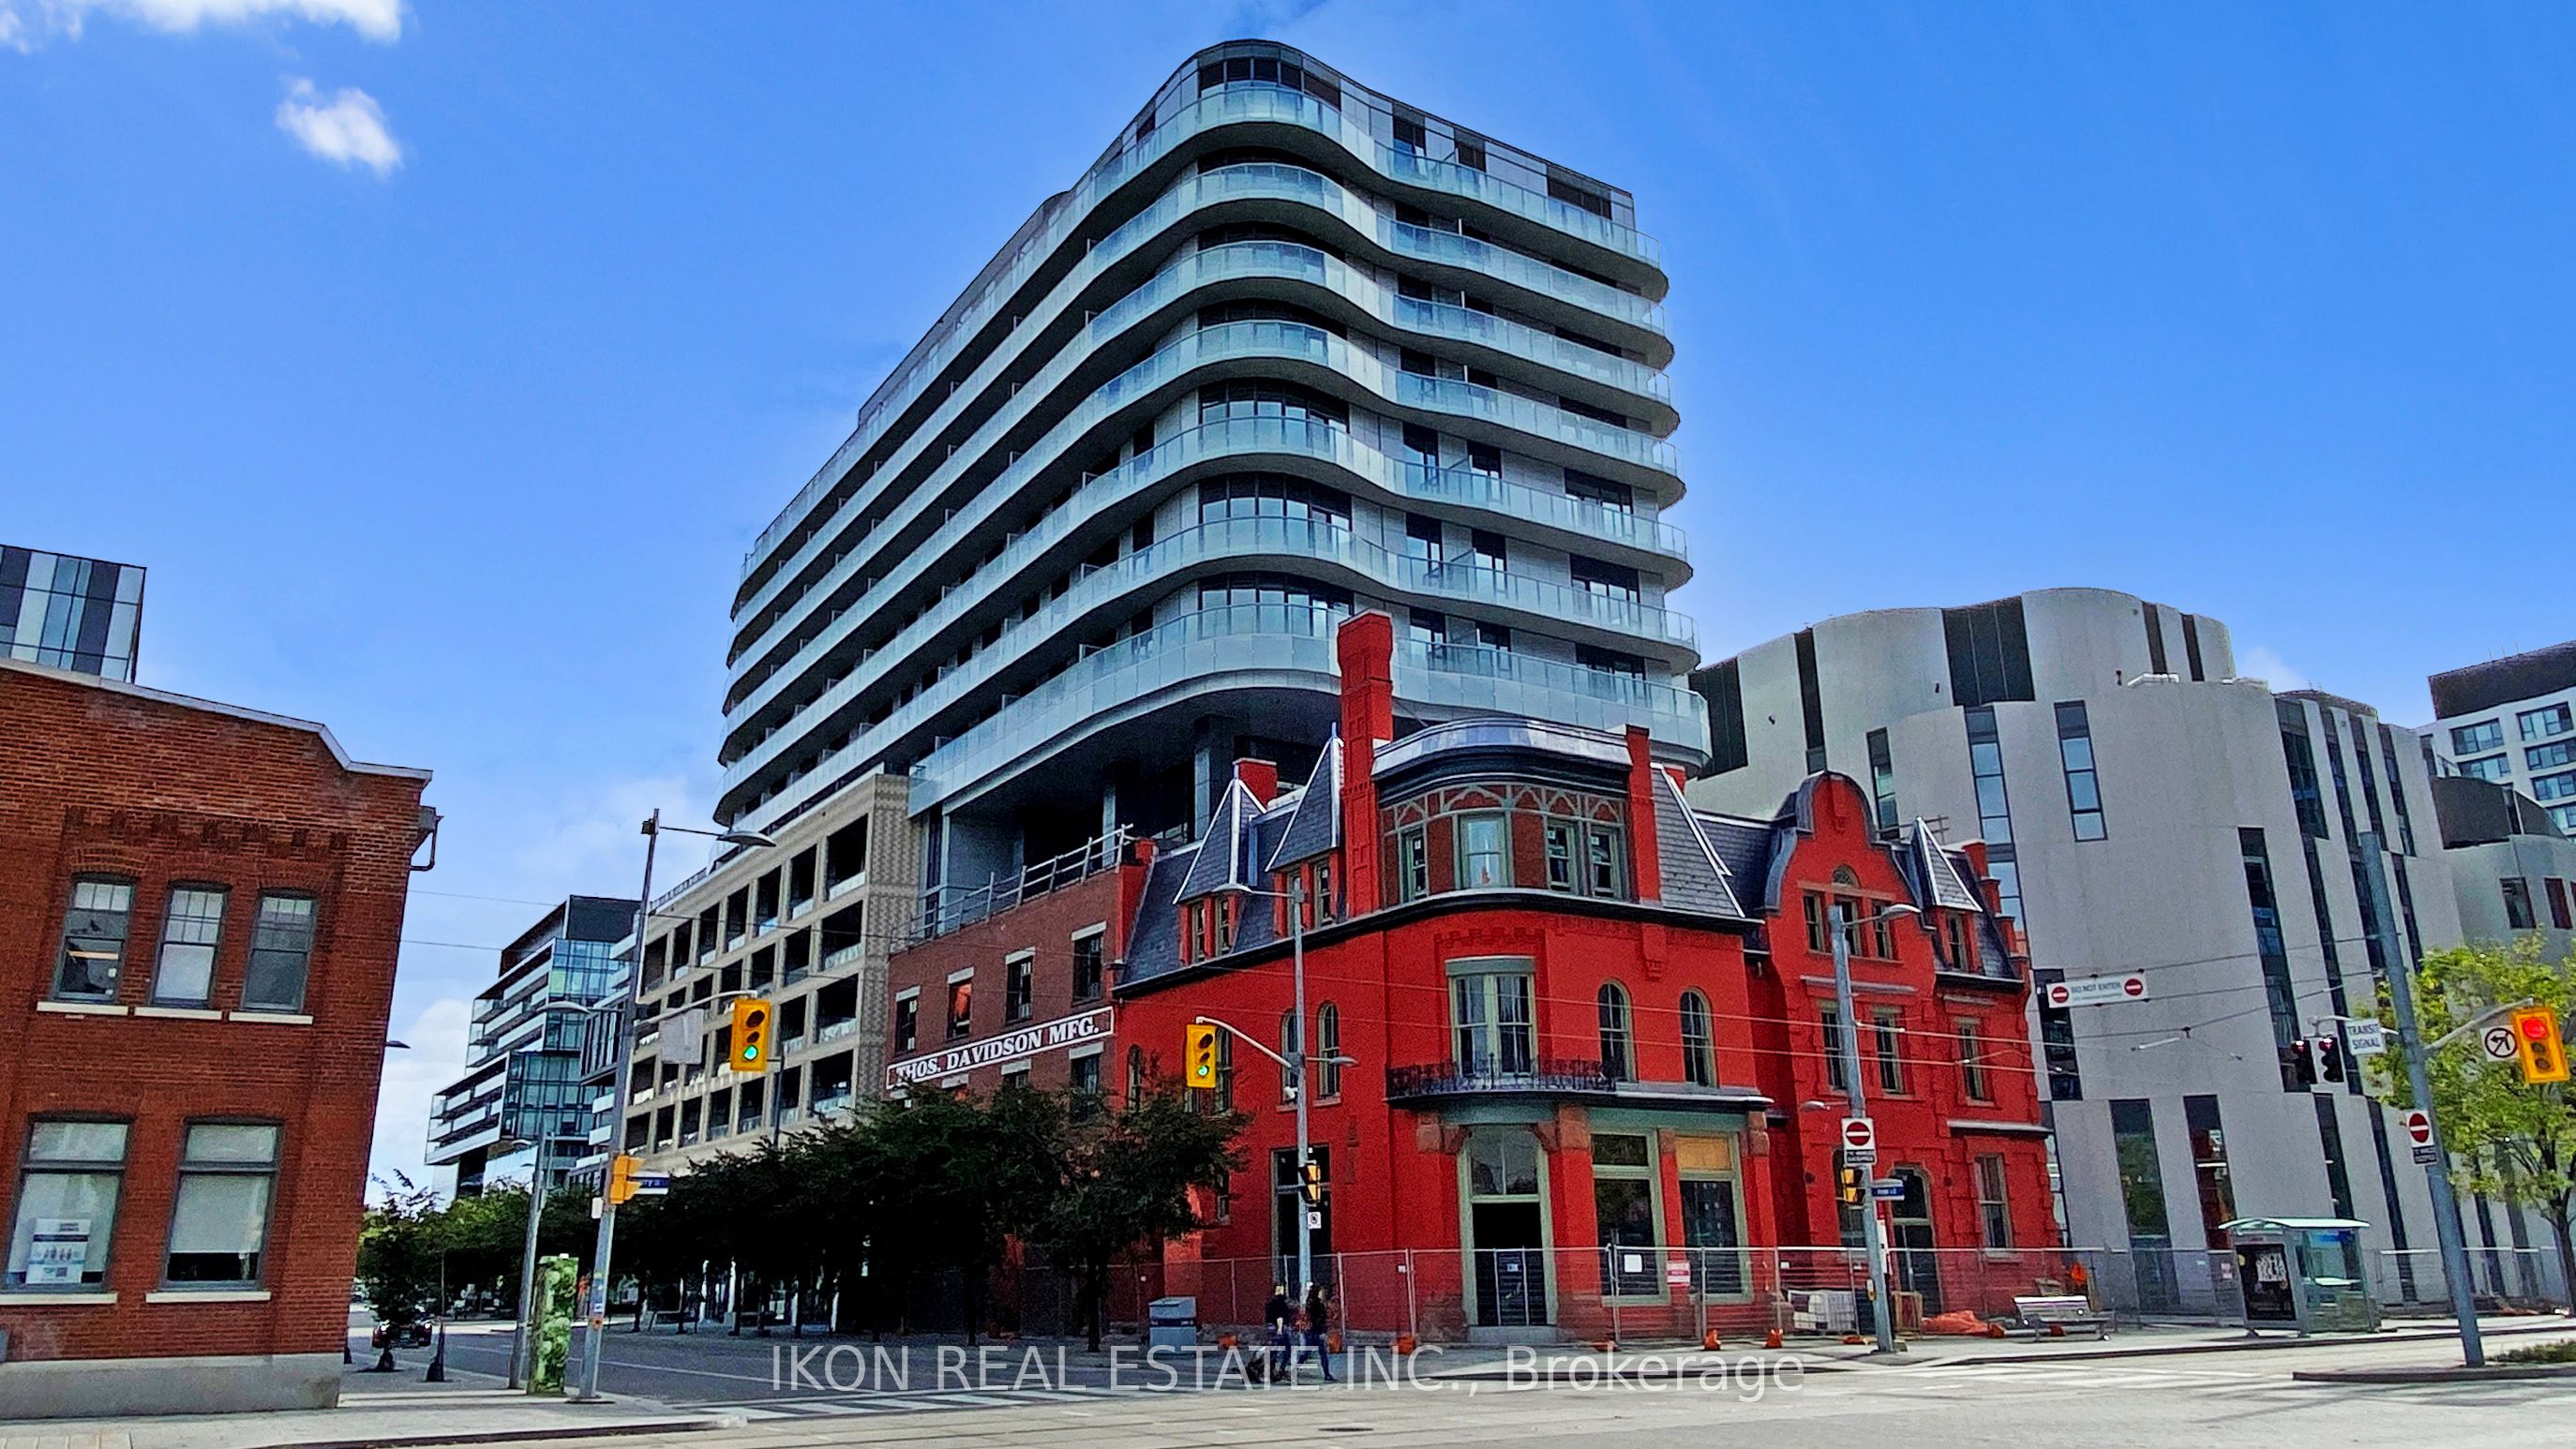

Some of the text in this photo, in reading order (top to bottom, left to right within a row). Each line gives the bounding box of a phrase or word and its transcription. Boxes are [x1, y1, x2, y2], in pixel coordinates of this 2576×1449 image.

[895, 1016, 1100, 1082] THOS. DAVIDSON MFG.
